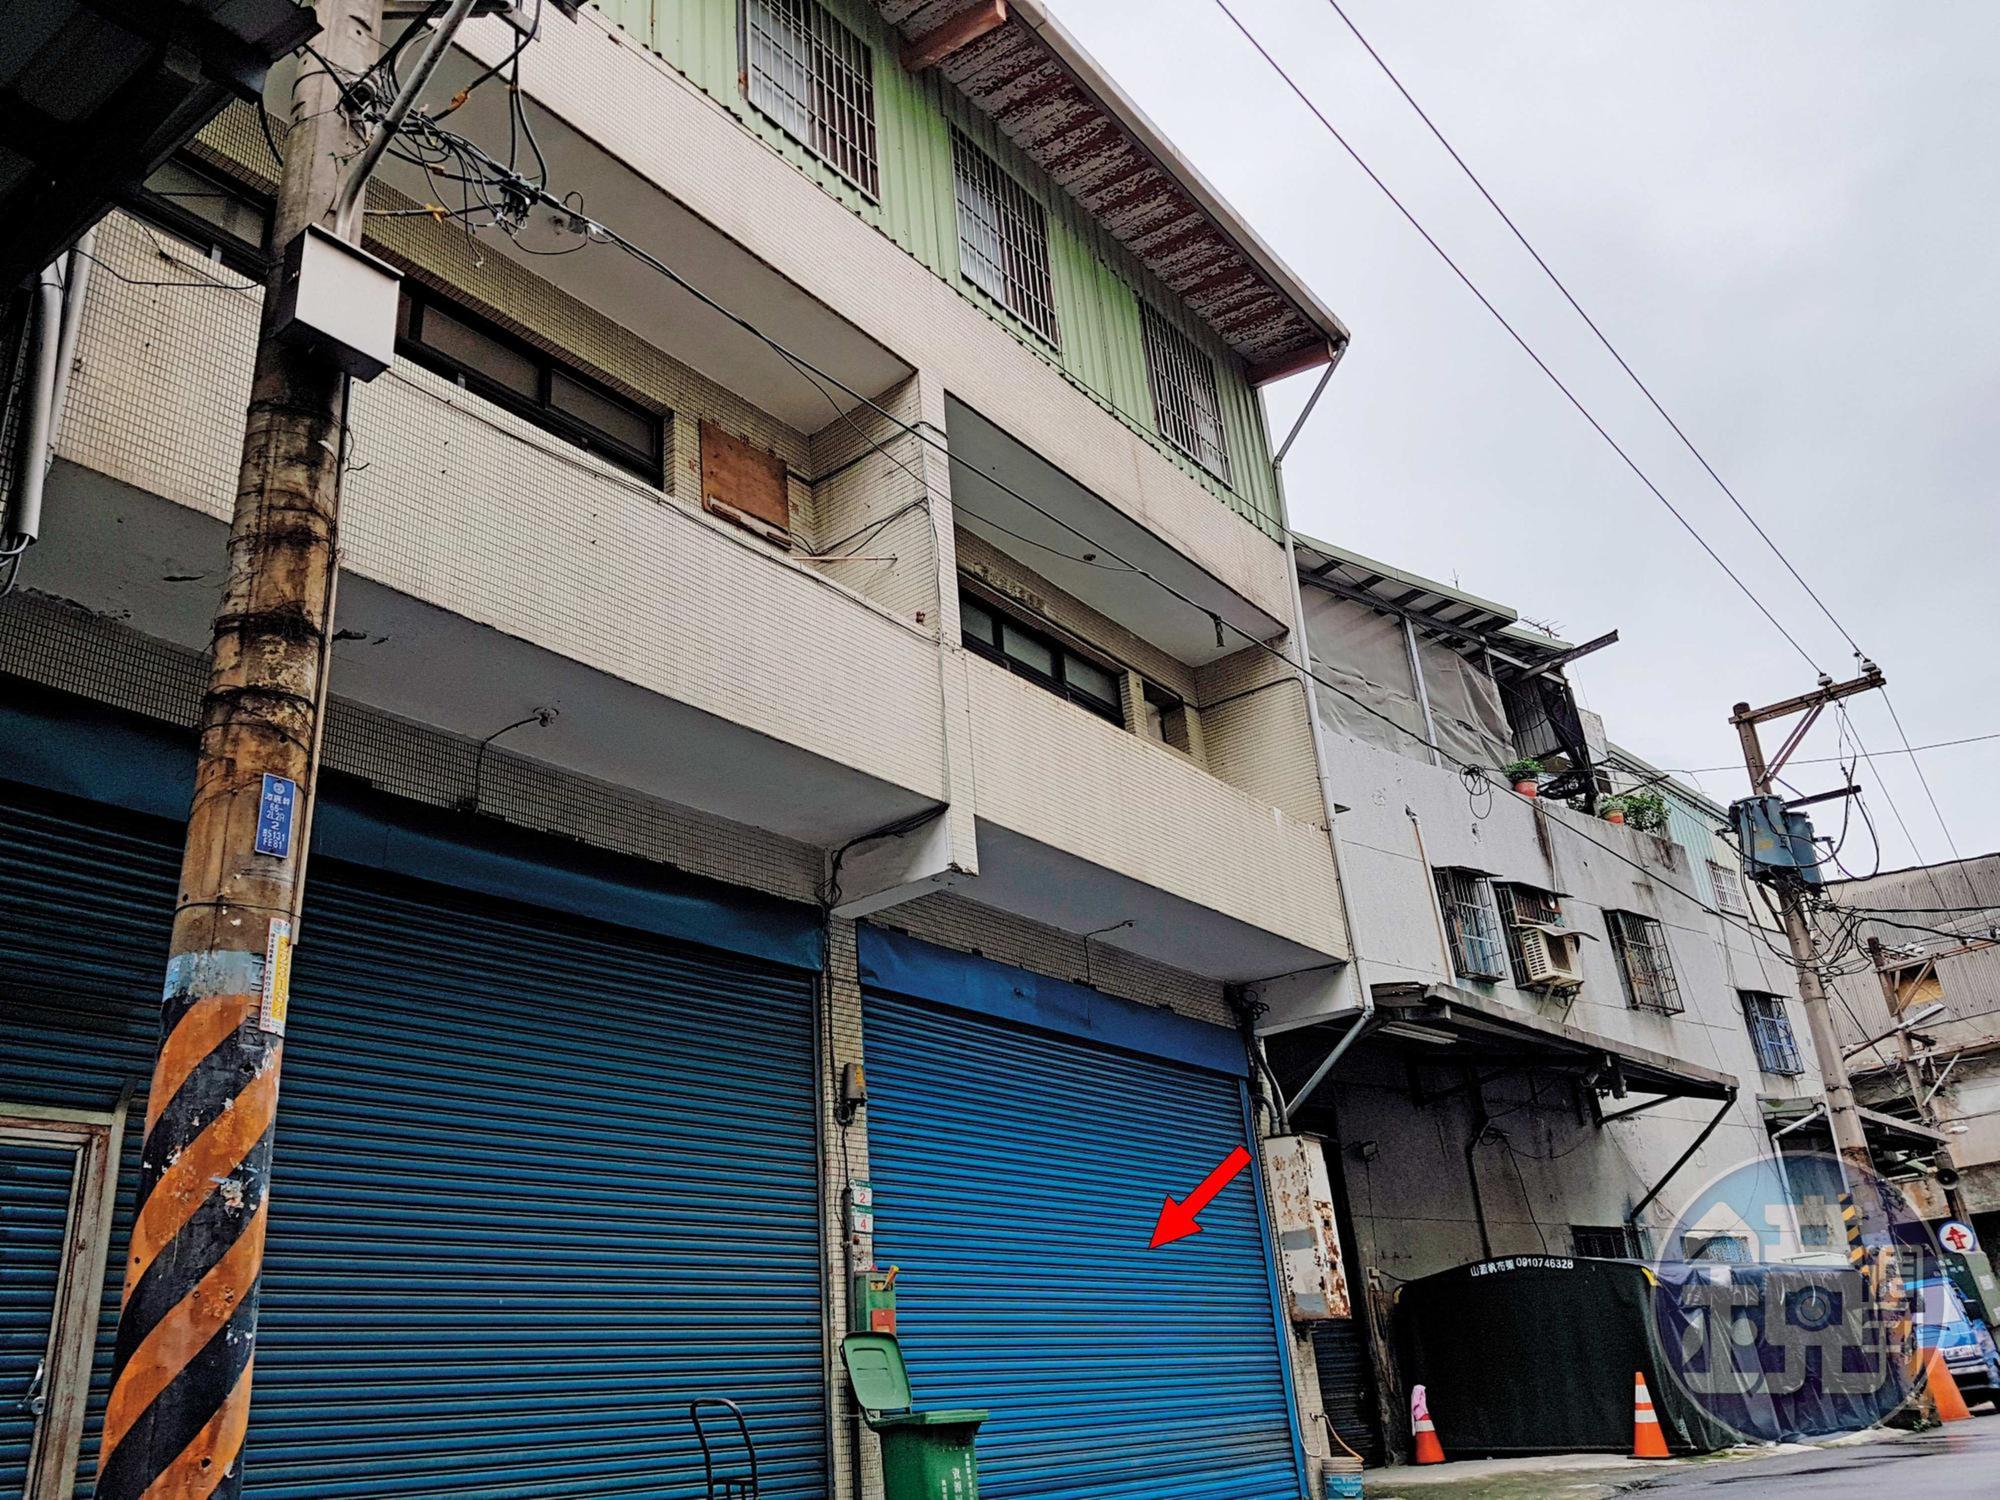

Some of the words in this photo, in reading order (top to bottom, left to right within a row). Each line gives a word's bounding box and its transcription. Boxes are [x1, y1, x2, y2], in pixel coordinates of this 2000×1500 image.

[271, 821, 280, 831] 2
[859, 1192, 866, 1204] 2
[860, 1218, 867, 1230] 4
[1515, 1257, 1574, 1270] 0910746328
